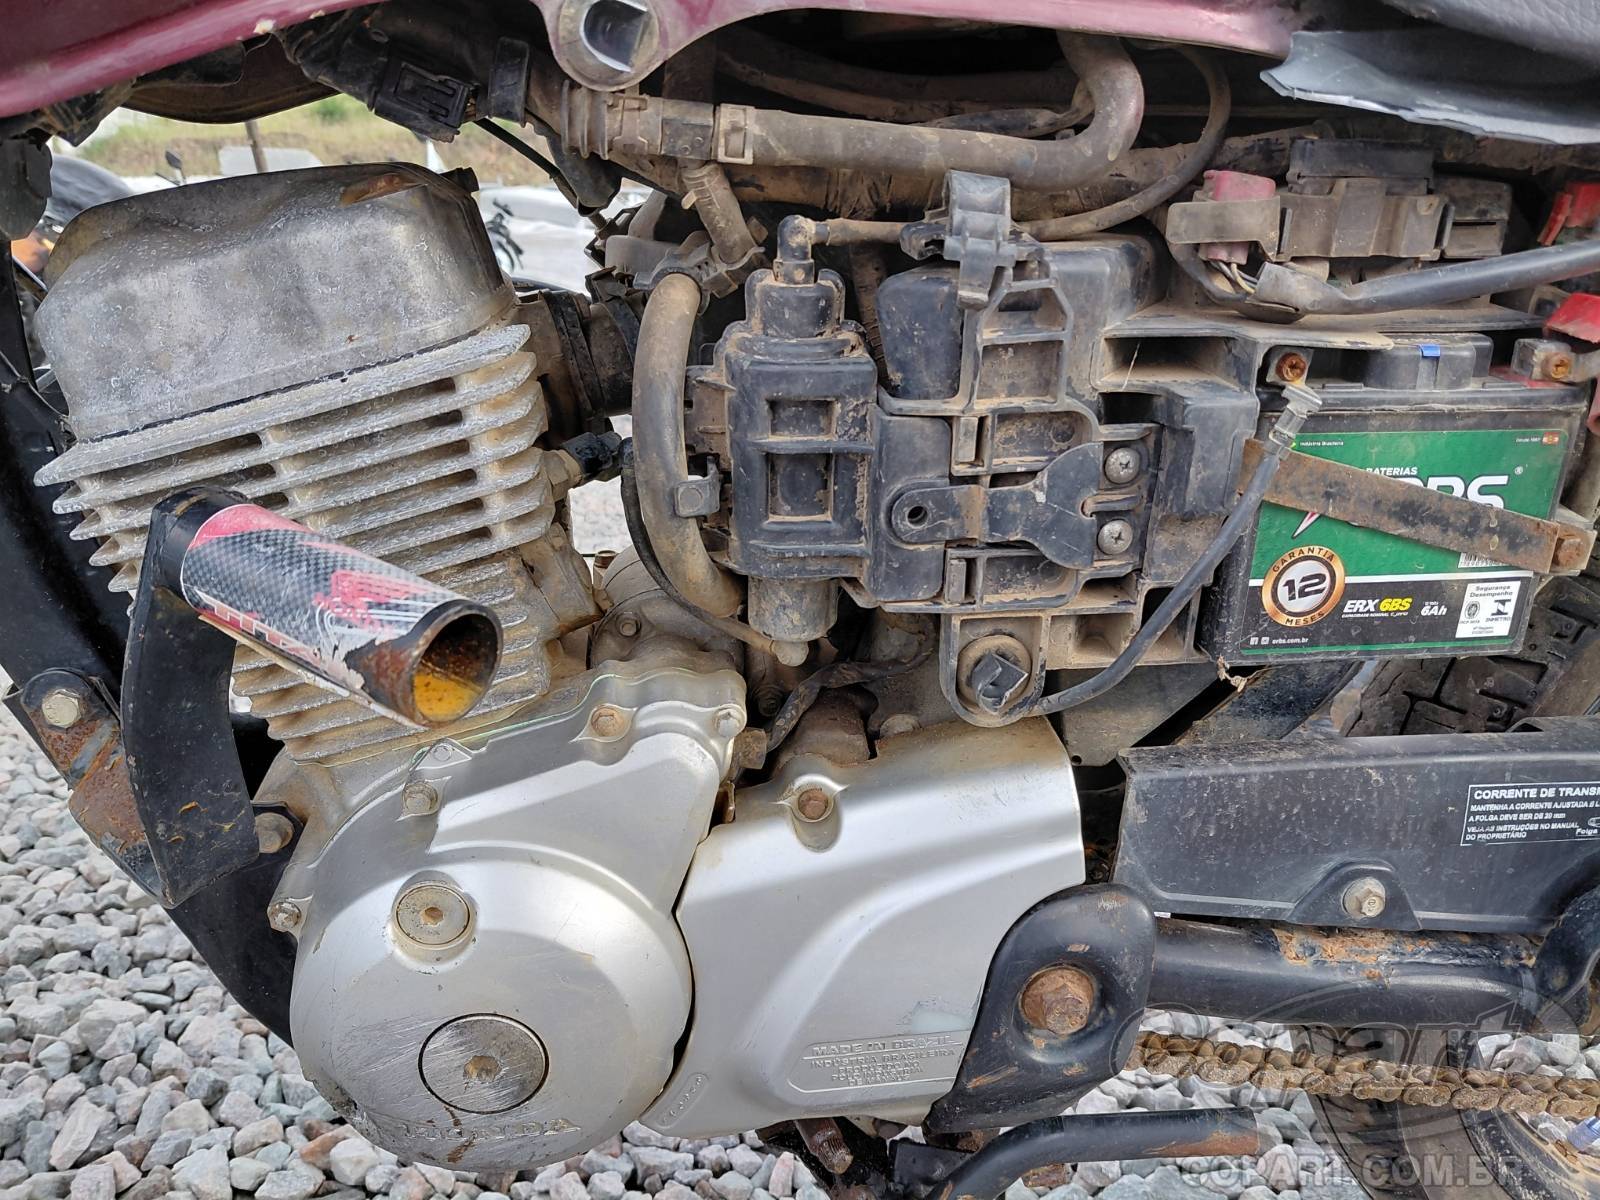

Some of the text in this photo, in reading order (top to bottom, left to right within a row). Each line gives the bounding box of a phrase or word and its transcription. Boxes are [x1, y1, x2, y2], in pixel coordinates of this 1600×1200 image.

[1272, 547, 1335, 573] GARANTIA
[1283, 573, 1327, 602] 12
[1343, 598, 1380, 613] ERX
[1420, 604, 1448, 616] 6Ah
[1285, 610, 1325, 626] MESES
[1474, 788, 1538, 800] CORRENTE
[1539, 787, 1557, 798] DE
[1470, 803, 1508, 812] MANTENHA
[1515, 802, 1553, 810] CORRENTE
[1552, 801, 1588, 809] AJUSTADA
[1474, 814, 1499, 822] FOLGA
[1499, 813, 1518, 821] DEVE
[1533, 812, 1545, 820] DE
[1539, 822, 1551, 830] NO
[1550, 822, 1580, 830] MANUAL
[1465, 833, 1477, 841] DO
[812, 1043, 863, 1057] MADE
[867, 1041, 886, 1051] IN
